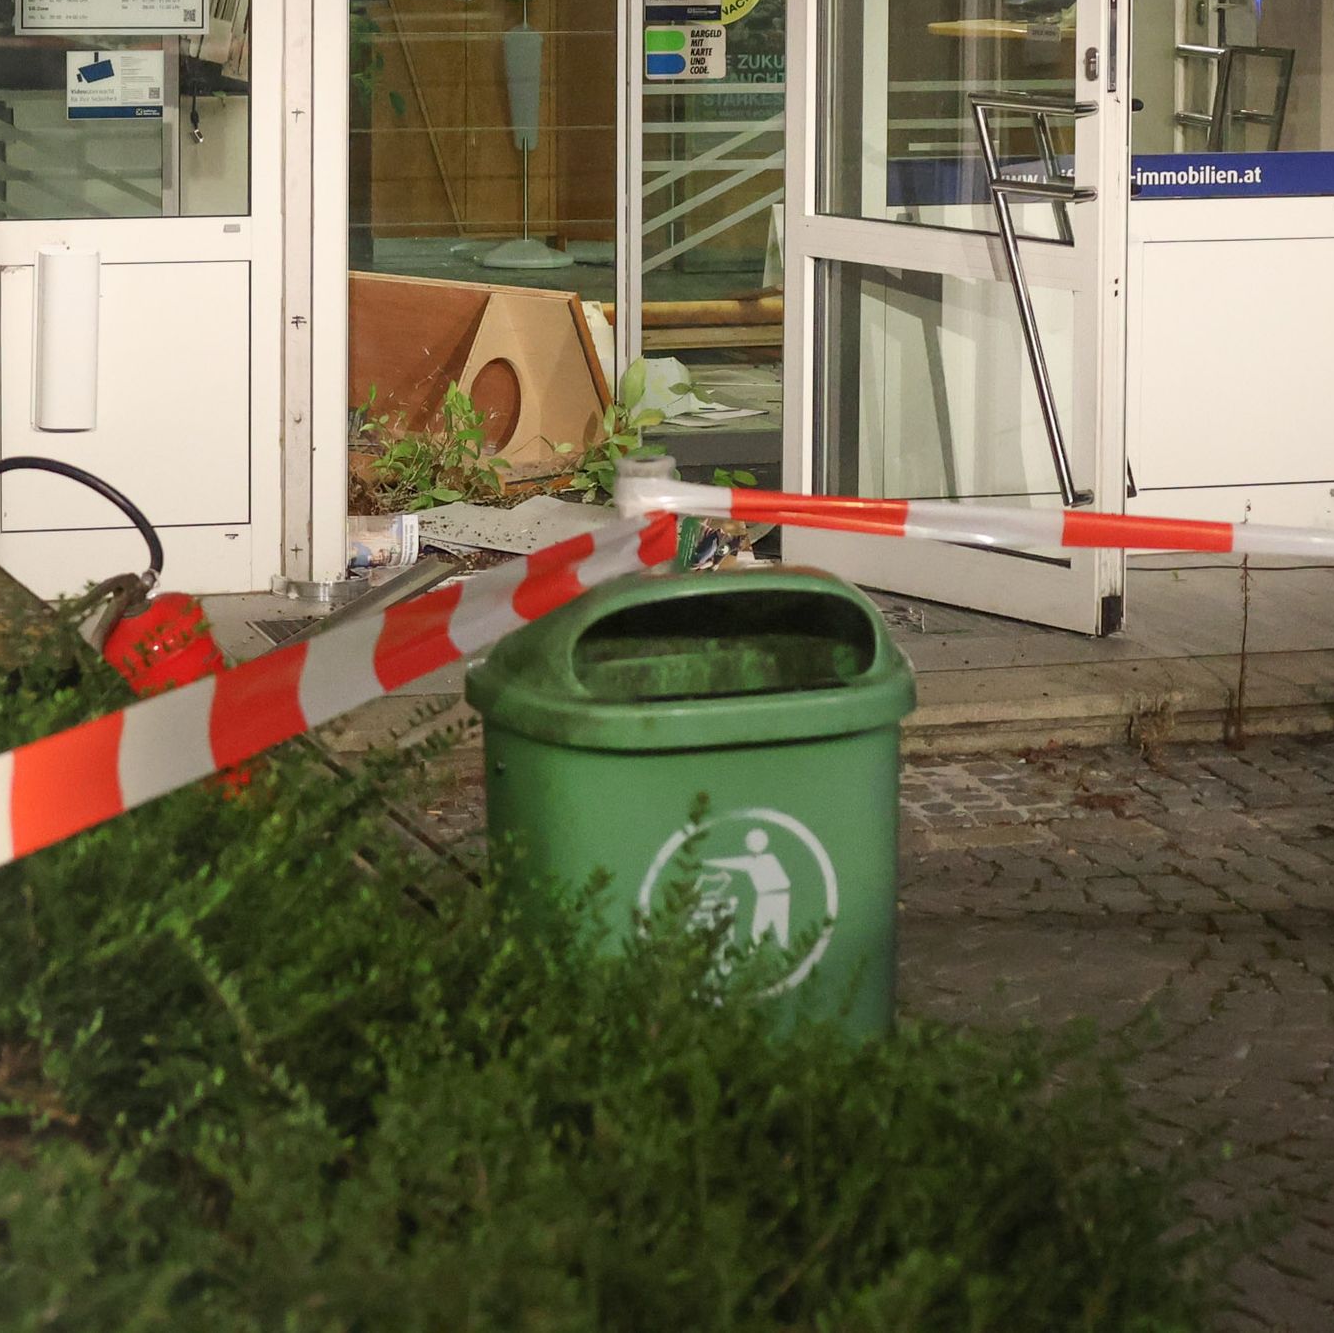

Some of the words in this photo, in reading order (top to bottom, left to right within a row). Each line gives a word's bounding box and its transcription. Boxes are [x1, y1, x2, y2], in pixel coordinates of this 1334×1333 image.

[690, 29, 722, 38] BARGELD
[690, 38, 704, 47] MIT
[690, 47, 713, 56] KARTE
[690, 57, 706, 65] UND
[1131, 167, 1262, 185] -immobilien.at
